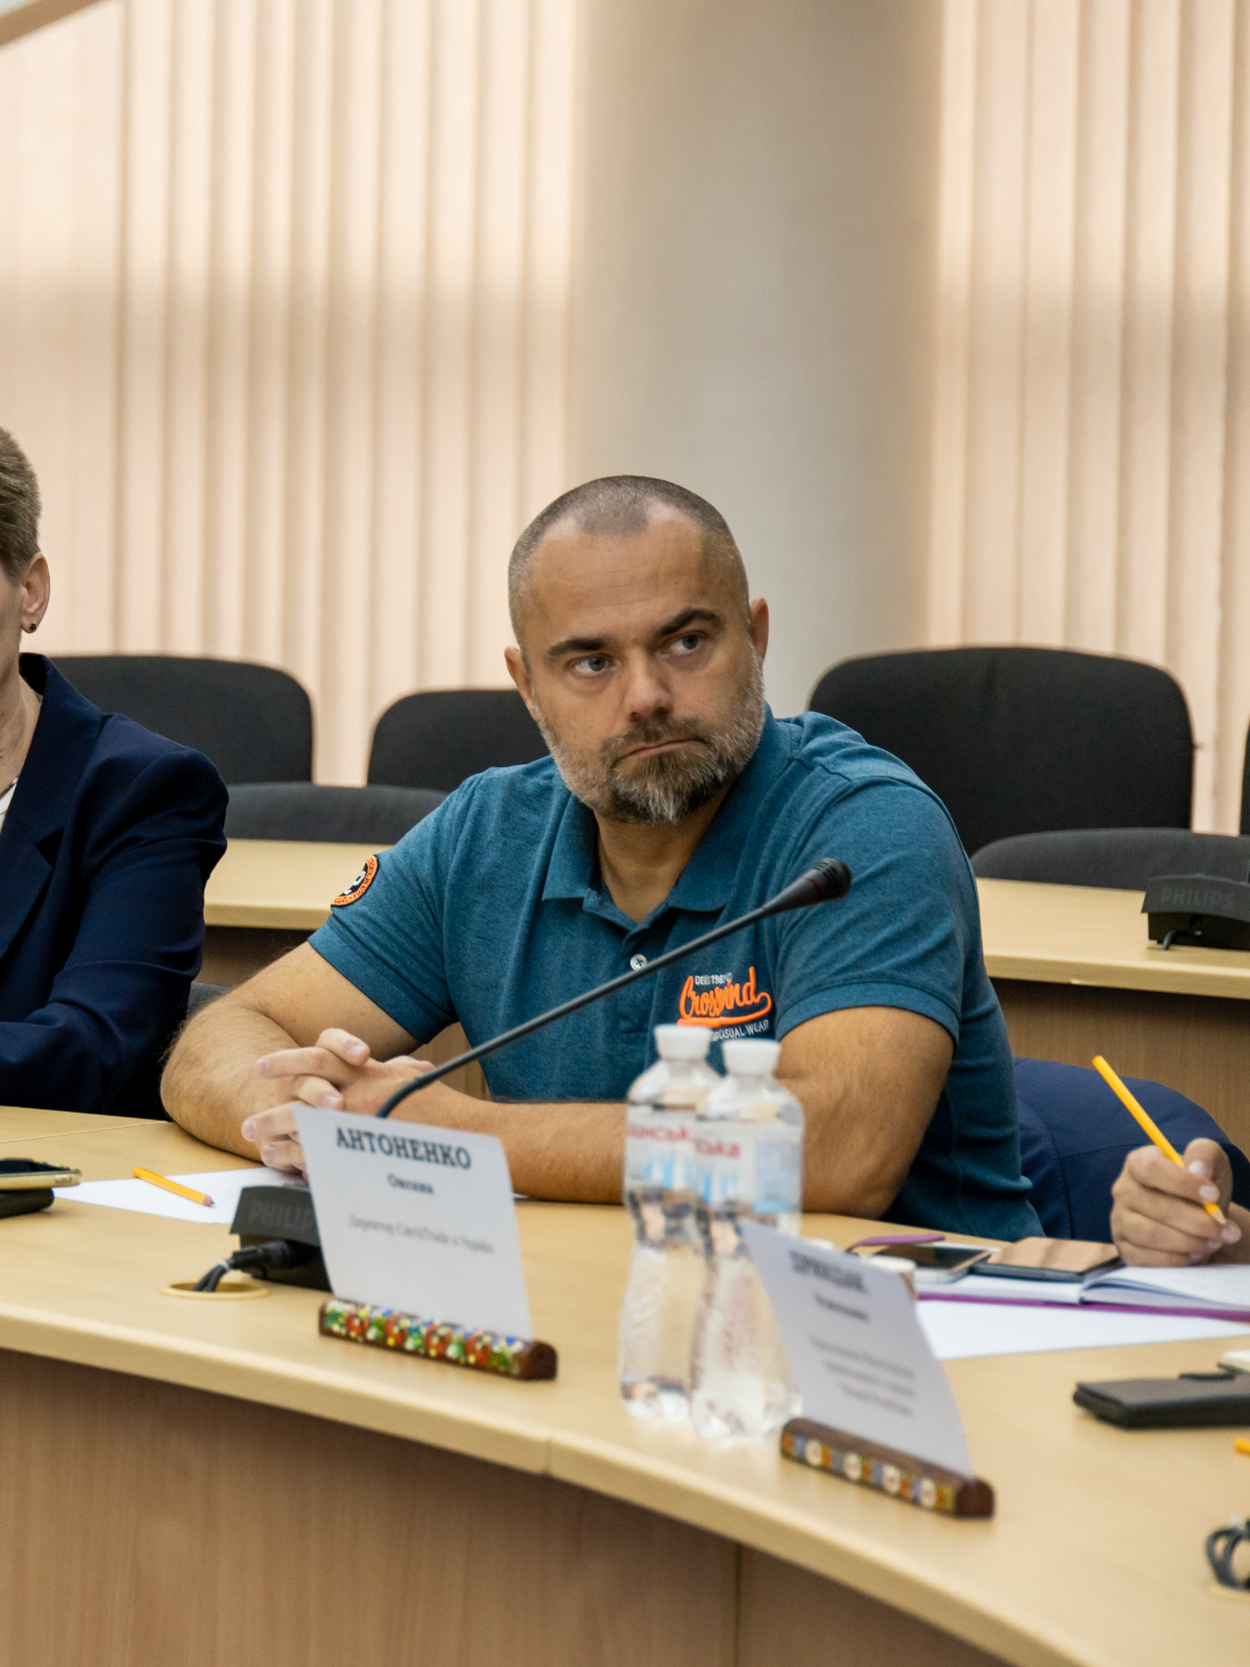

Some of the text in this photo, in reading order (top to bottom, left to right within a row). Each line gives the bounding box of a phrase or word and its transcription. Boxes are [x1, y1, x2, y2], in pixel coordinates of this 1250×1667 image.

[1160, 887, 1236, 910] PHILIPS
[744, 1019, 770, 1036] WEAR
[336, 1127, 472, 1170] АНТОНЕНКО
